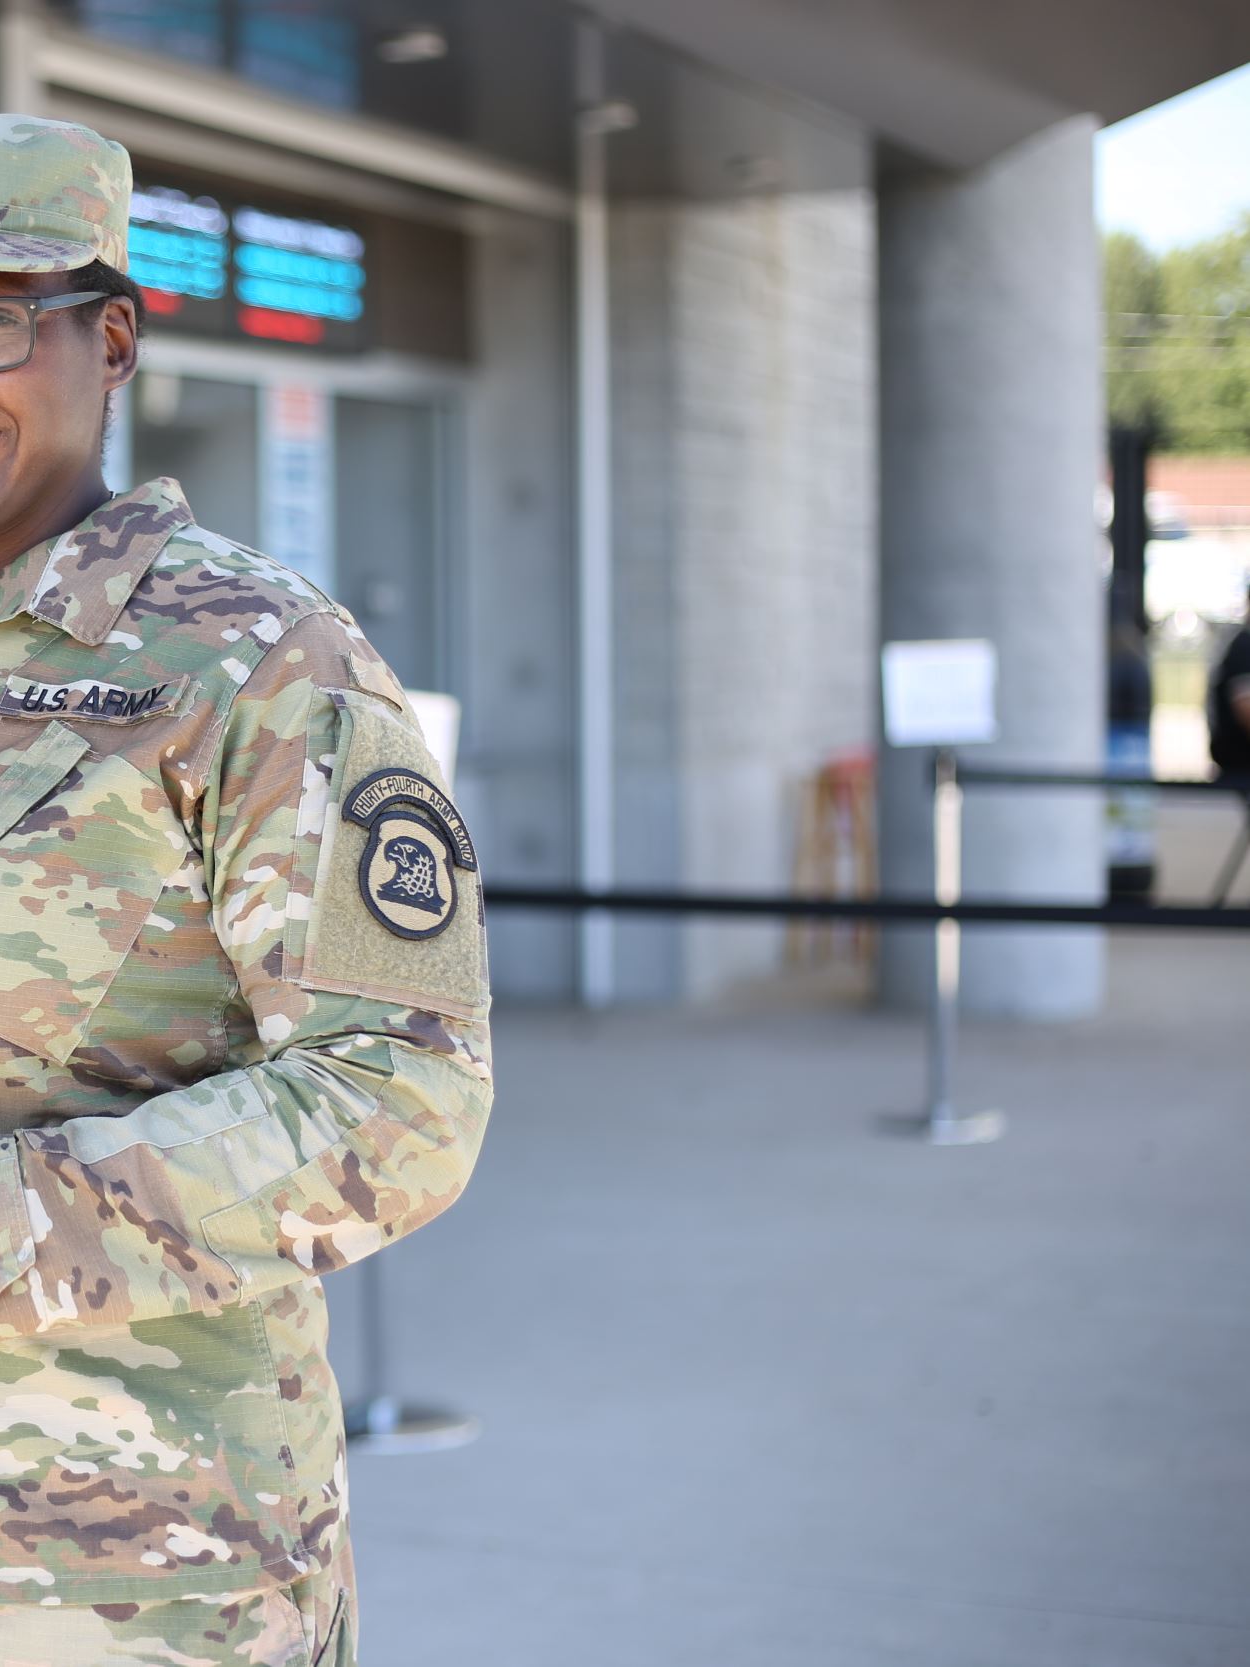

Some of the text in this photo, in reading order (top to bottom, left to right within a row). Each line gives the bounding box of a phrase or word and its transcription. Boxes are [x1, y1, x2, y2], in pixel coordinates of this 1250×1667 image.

[21, 684, 168, 717] U.S. ARMY
[353, 776, 474, 862] THIRTY-FOURTH ARMY BAND
